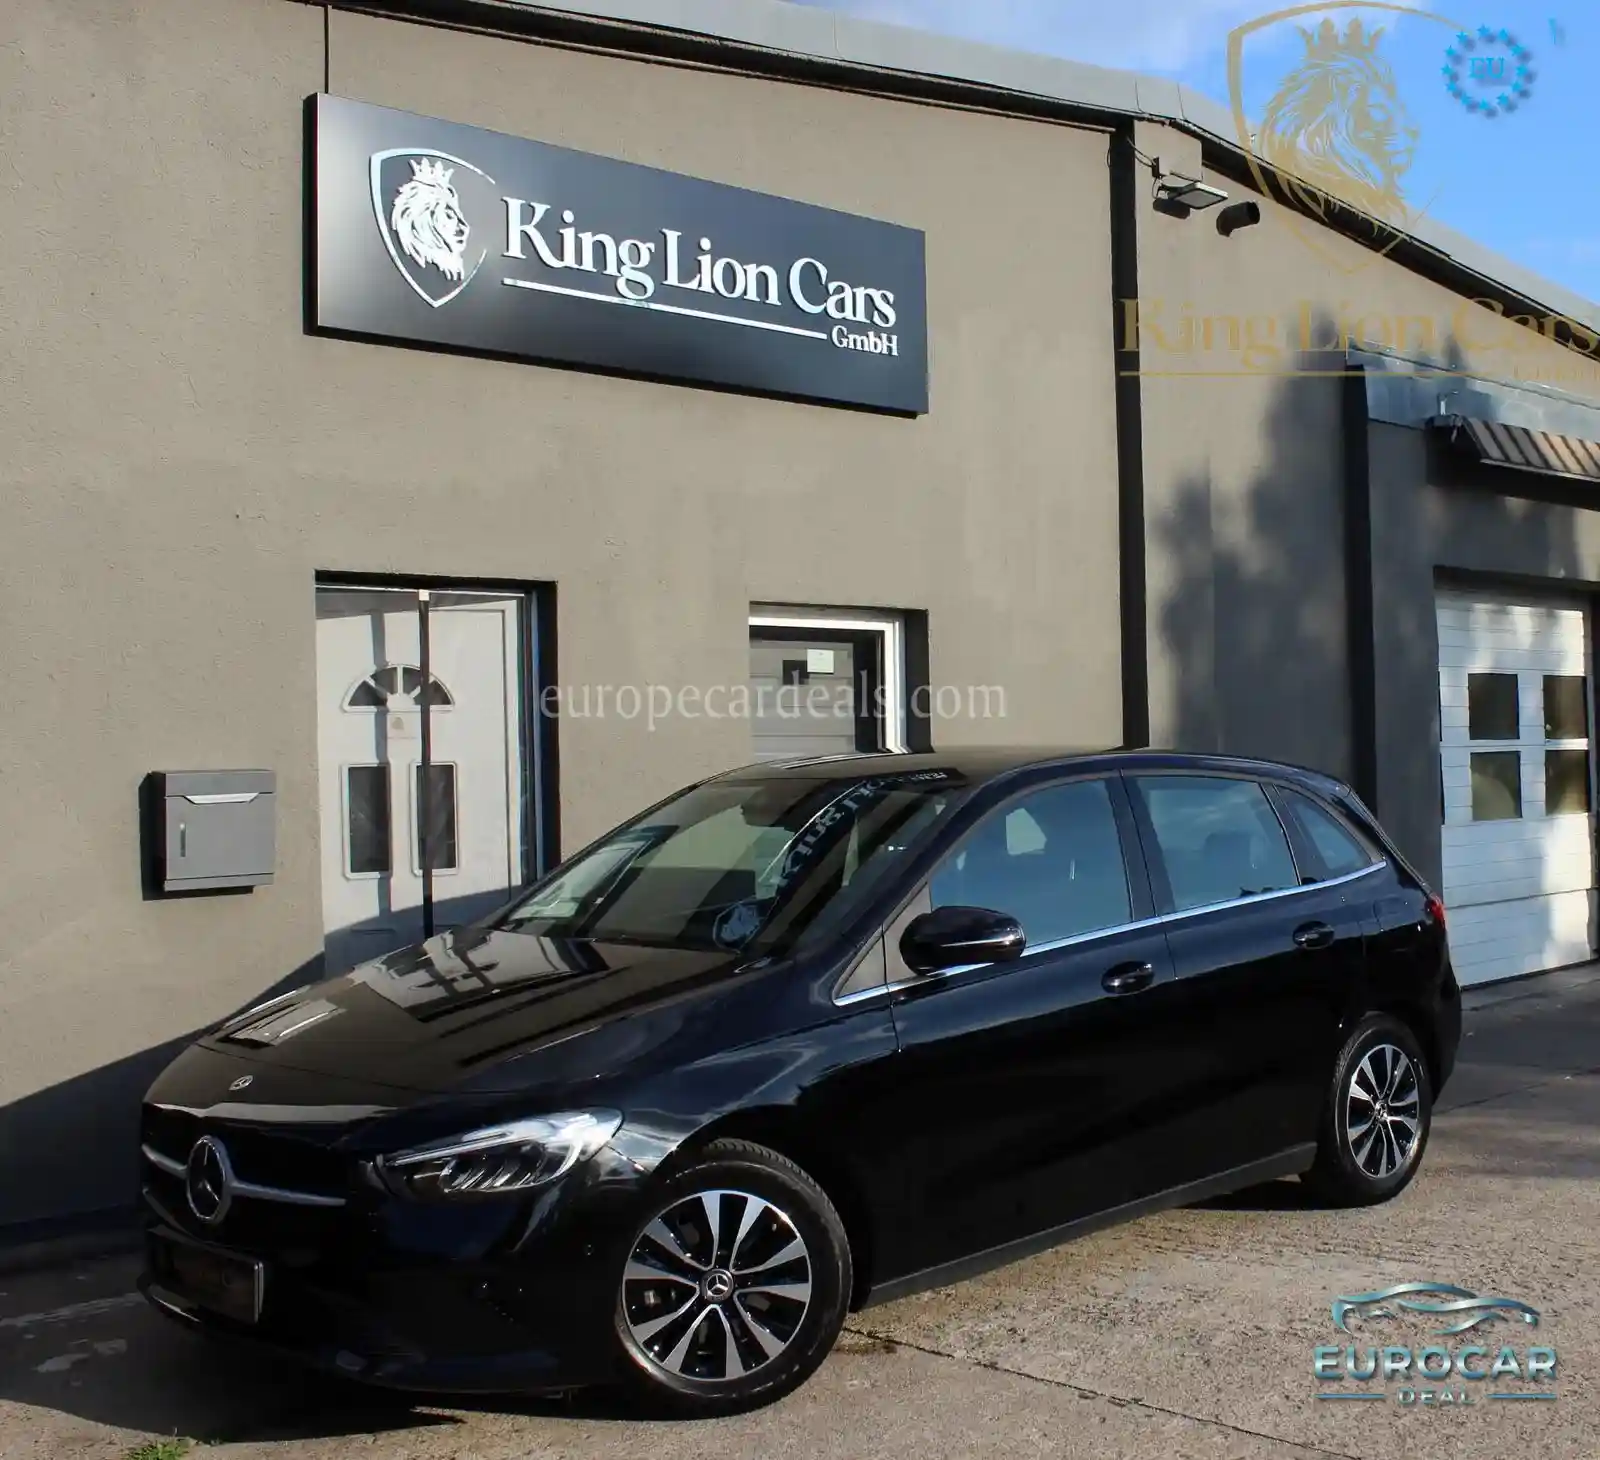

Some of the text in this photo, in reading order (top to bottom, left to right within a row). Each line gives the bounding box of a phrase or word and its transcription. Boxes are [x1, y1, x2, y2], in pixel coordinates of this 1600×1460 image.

[501, 196, 896, 328] King Lion Cars
[832, 325, 899, 357] GmbH
